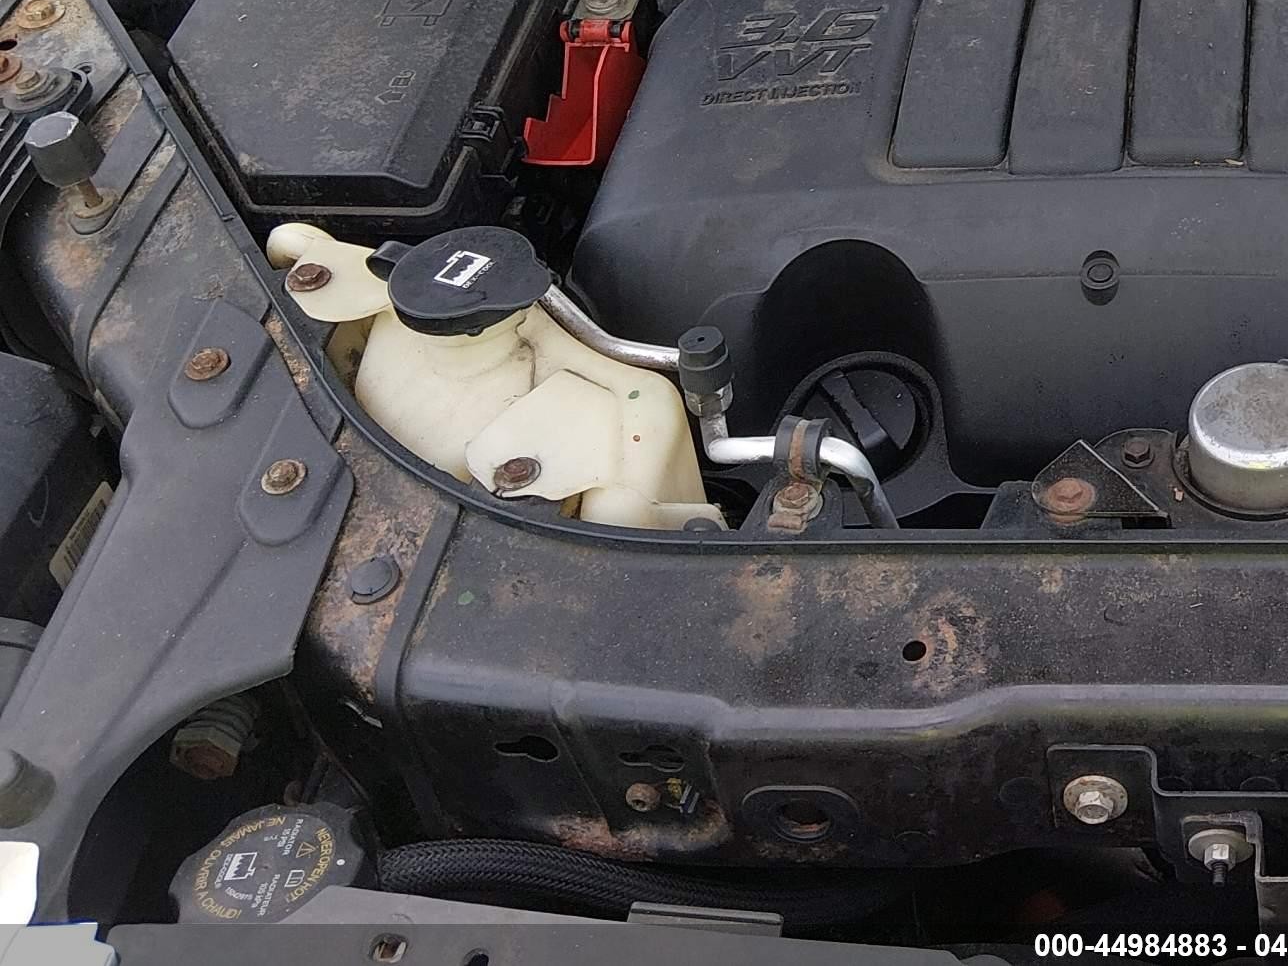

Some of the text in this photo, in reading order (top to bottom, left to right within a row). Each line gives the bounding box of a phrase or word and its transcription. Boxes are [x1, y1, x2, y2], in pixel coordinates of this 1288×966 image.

[717, 43, 873, 81] VVT
[701, 81, 862, 106] DIRECT INJECTION
[220, 820, 266, 848] JAMAIS
[266, 816, 287, 829] NE
[281, 818, 304, 856] RADIATOR
[316, 827, 335, 860] NEVER
[193, 849, 222, 891] OUVRIR
[306, 856, 331, 882] OPEN
